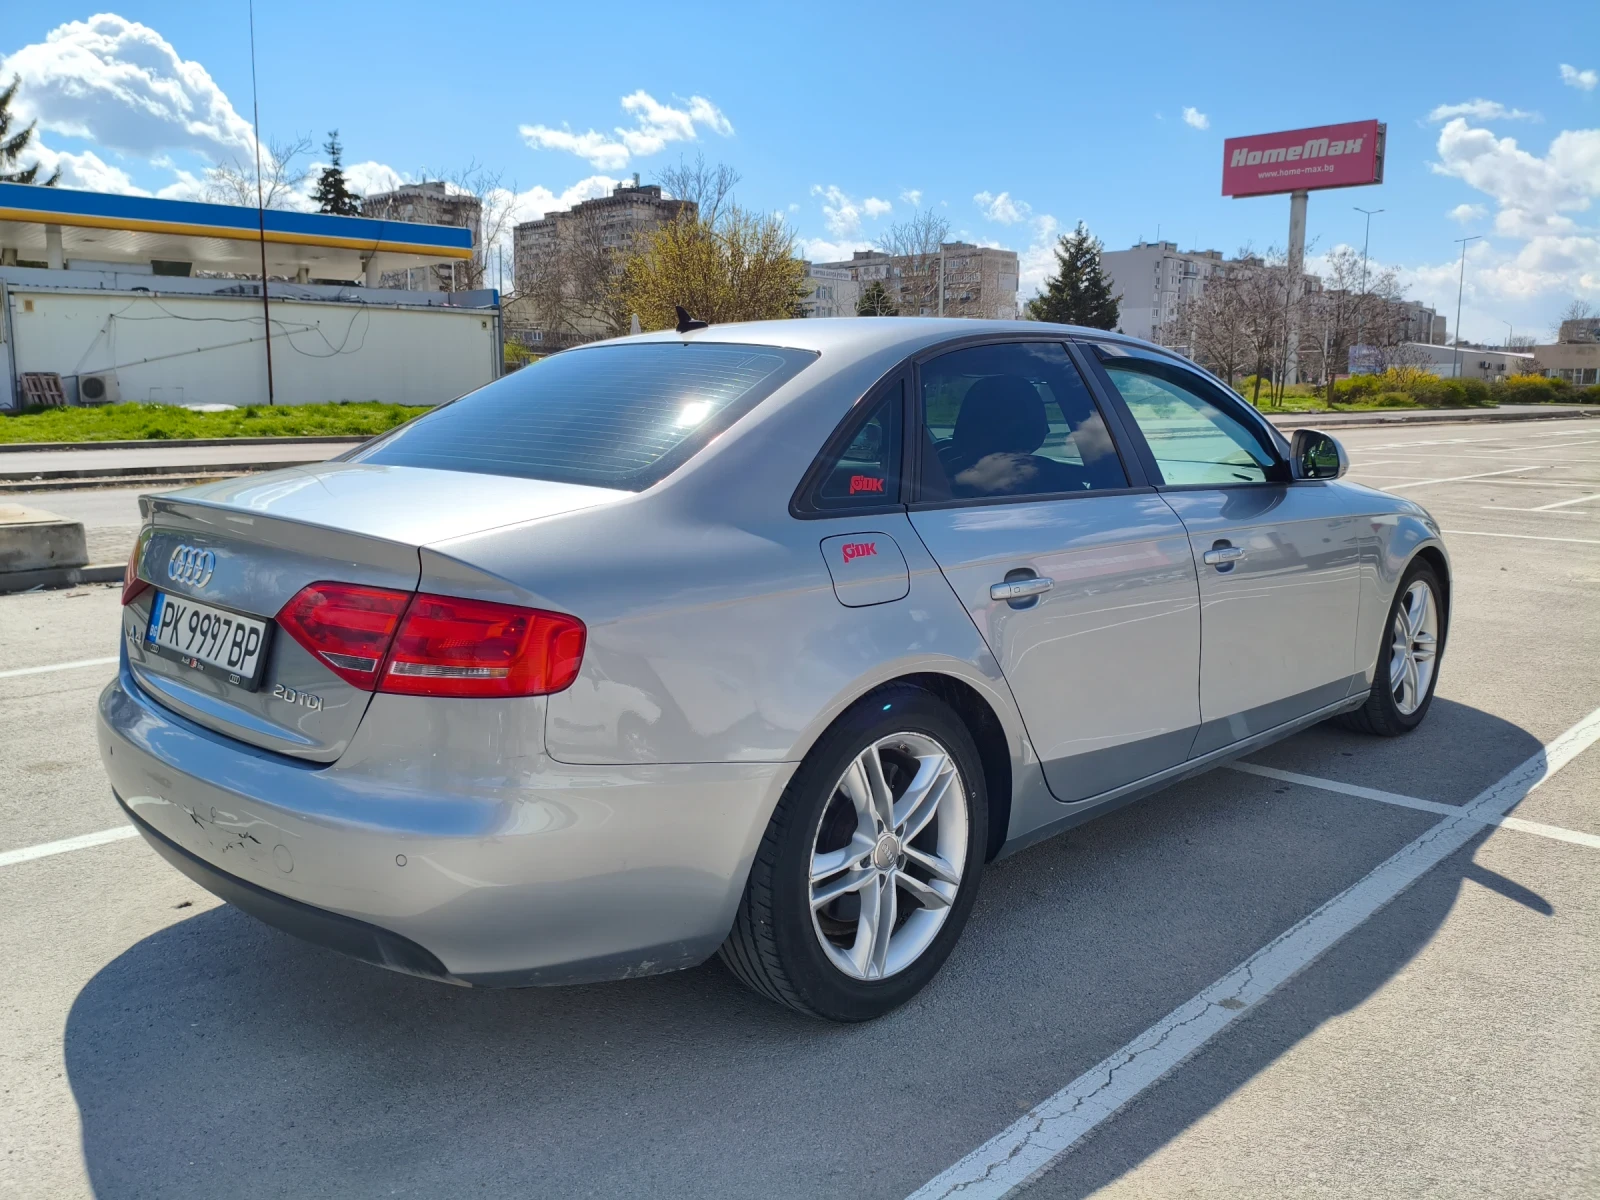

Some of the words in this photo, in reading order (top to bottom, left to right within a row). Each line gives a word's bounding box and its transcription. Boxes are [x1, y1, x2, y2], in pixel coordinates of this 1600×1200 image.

[1258, 163, 1335, 179] www.home-max.bg
[129, 625, 144, 645] A4
[149, 624, 158, 637] BG
[159, 601, 187, 647] PK
[186, 610, 233, 661] 9997
[227, 622, 260, 671] BP
[181, 656, 190, 664] Audi
[298, 690, 325, 712] TDI
